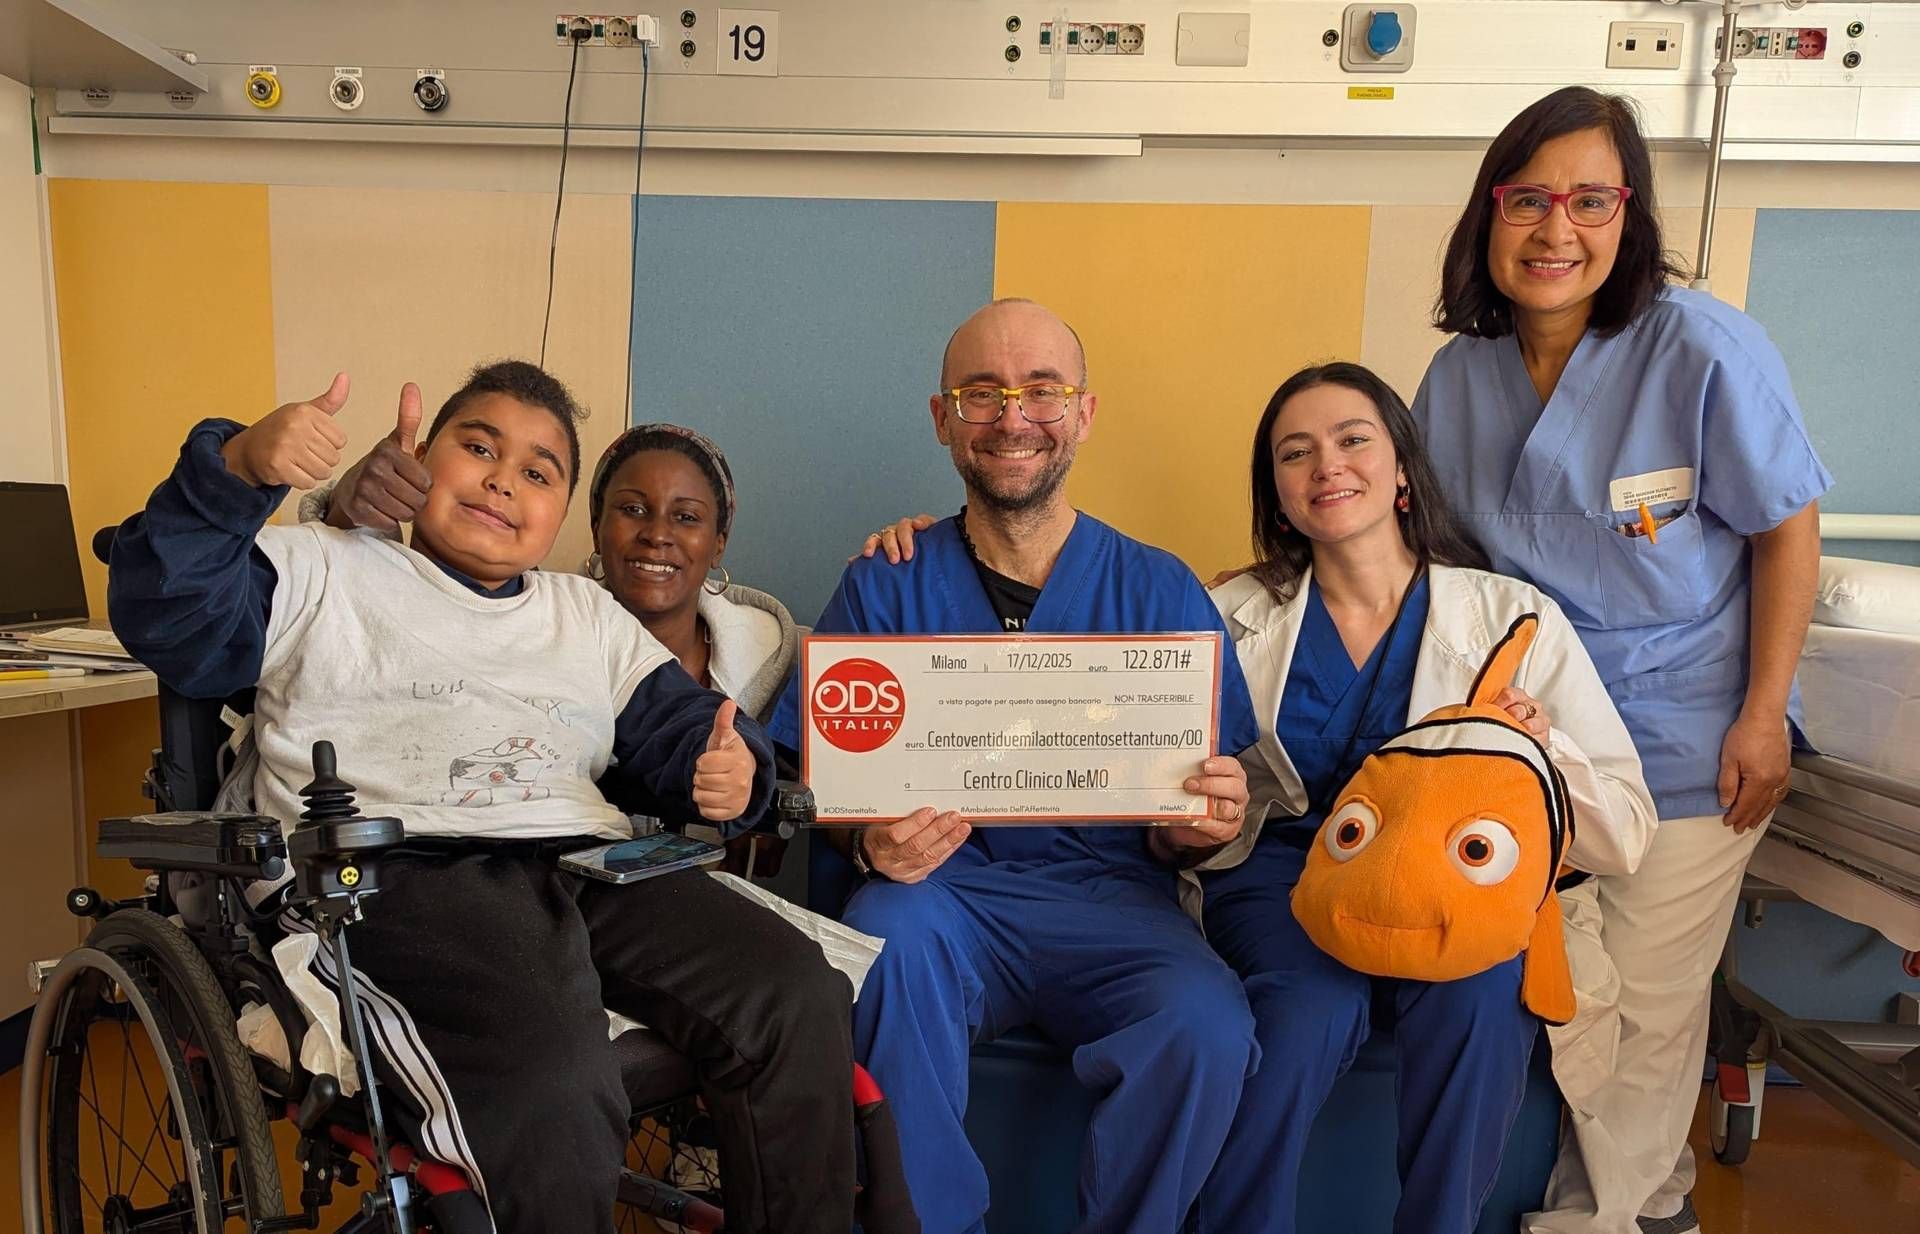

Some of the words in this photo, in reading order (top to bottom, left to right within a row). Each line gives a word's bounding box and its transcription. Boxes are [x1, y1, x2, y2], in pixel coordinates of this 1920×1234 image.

[729, 24, 765, 62] 19
[931, 654, 967, 670] Milano
[1007, 653, 1073, 671] 17/12/2025
[1088, 664, 1109, 672] euro
[1122, 649, 1193, 669] 122.871#
[412, 679, 464, 700] LUIS
[815, 680, 900, 714] ODS
[946, 697, 963, 705] vista
[965, 697, 992, 707] pagate
[994, 698, 1007, 707] per
[1008, 697, 1034, 707] questo
[1035, 698, 1066, 707] assegno
[1068, 696, 1102, 705] bancario
[1114, 694, 1135, 703] NON
[1137, 694, 1195, 703] TRASFERIBILE
[823, 719, 894, 731] ITALIA
[927, 729, 1203, 749] Centoventiduemilaottocentosettantuno/00
[963, 769, 1012, 789] Centro
[1015, 769, 1063, 789] Clinico
[1066, 768, 1109, 788] NeMO
[960, 804, 1008, 814] #Ambulatorio
[1159, 804, 1187, 812] #NeMO
